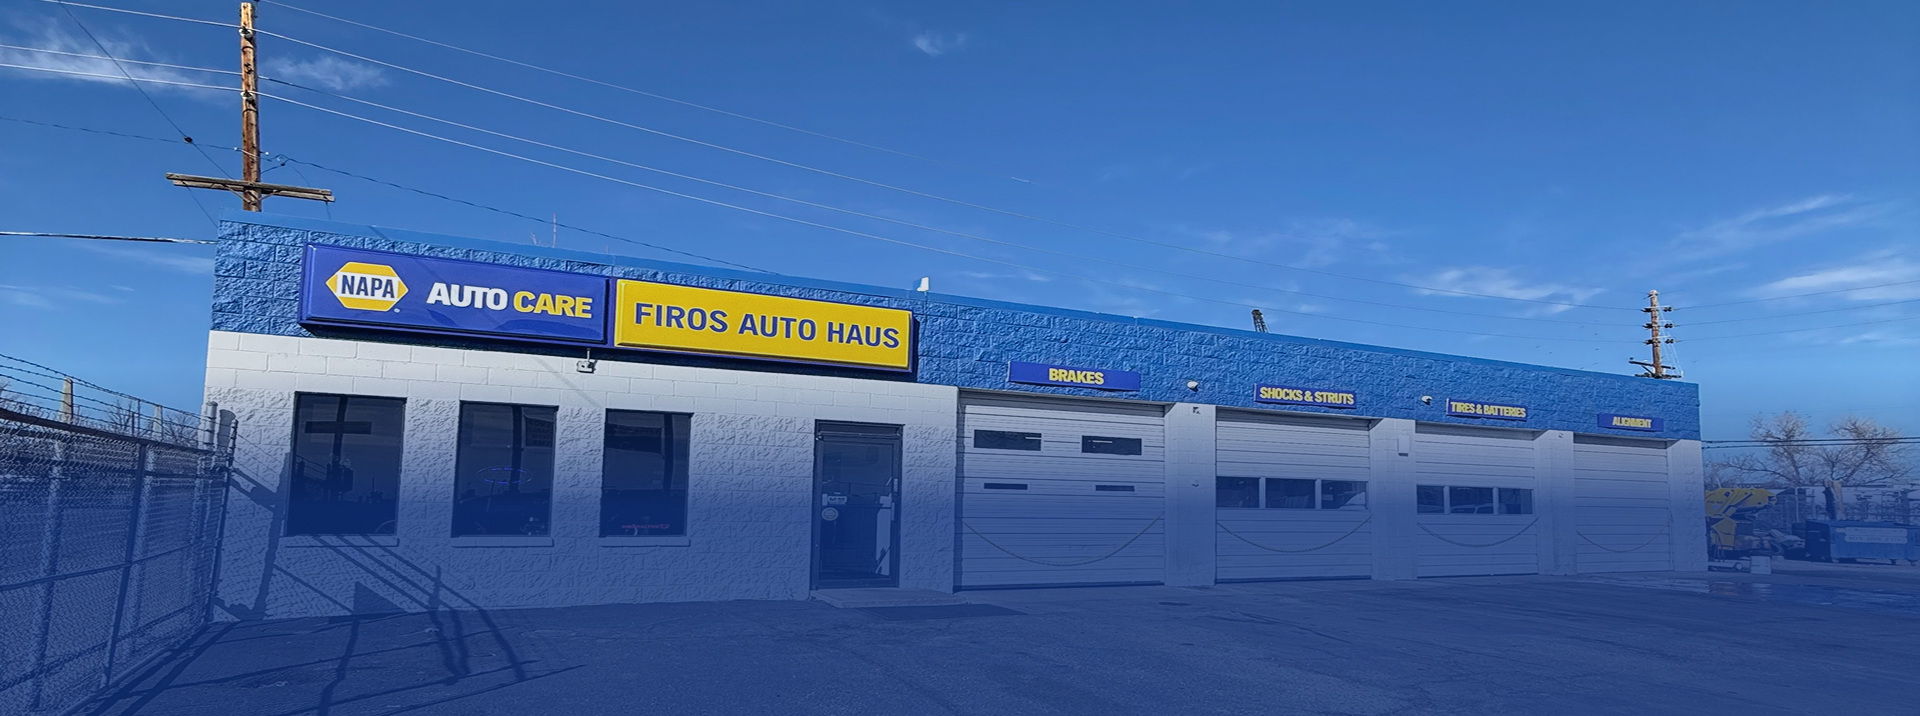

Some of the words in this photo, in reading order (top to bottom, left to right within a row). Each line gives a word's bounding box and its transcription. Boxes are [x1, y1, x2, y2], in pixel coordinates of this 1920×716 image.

[341, 274, 395, 299] NAPA
[426, 282, 508, 310] AUTO
[513, 291, 593, 318] CARE
[635, 302, 728, 333] FIROS
[738, 313, 817, 341] AUTO
[827, 321, 900, 349] HAUS
[1048, 367, 1105, 385] BRAKES
[1259, 386, 1303, 402] SHOCKS
[1304, 390, 1313, 402] &
[1314, 391, 1355, 405] STRUTS
[1450, 401, 1475, 414] TIRES
[1476, 403, 1483, 414] &
[1483, 404, 1527, 418] BATTERIES
[1612, 416, 1652, 429] ALIGNMENT
